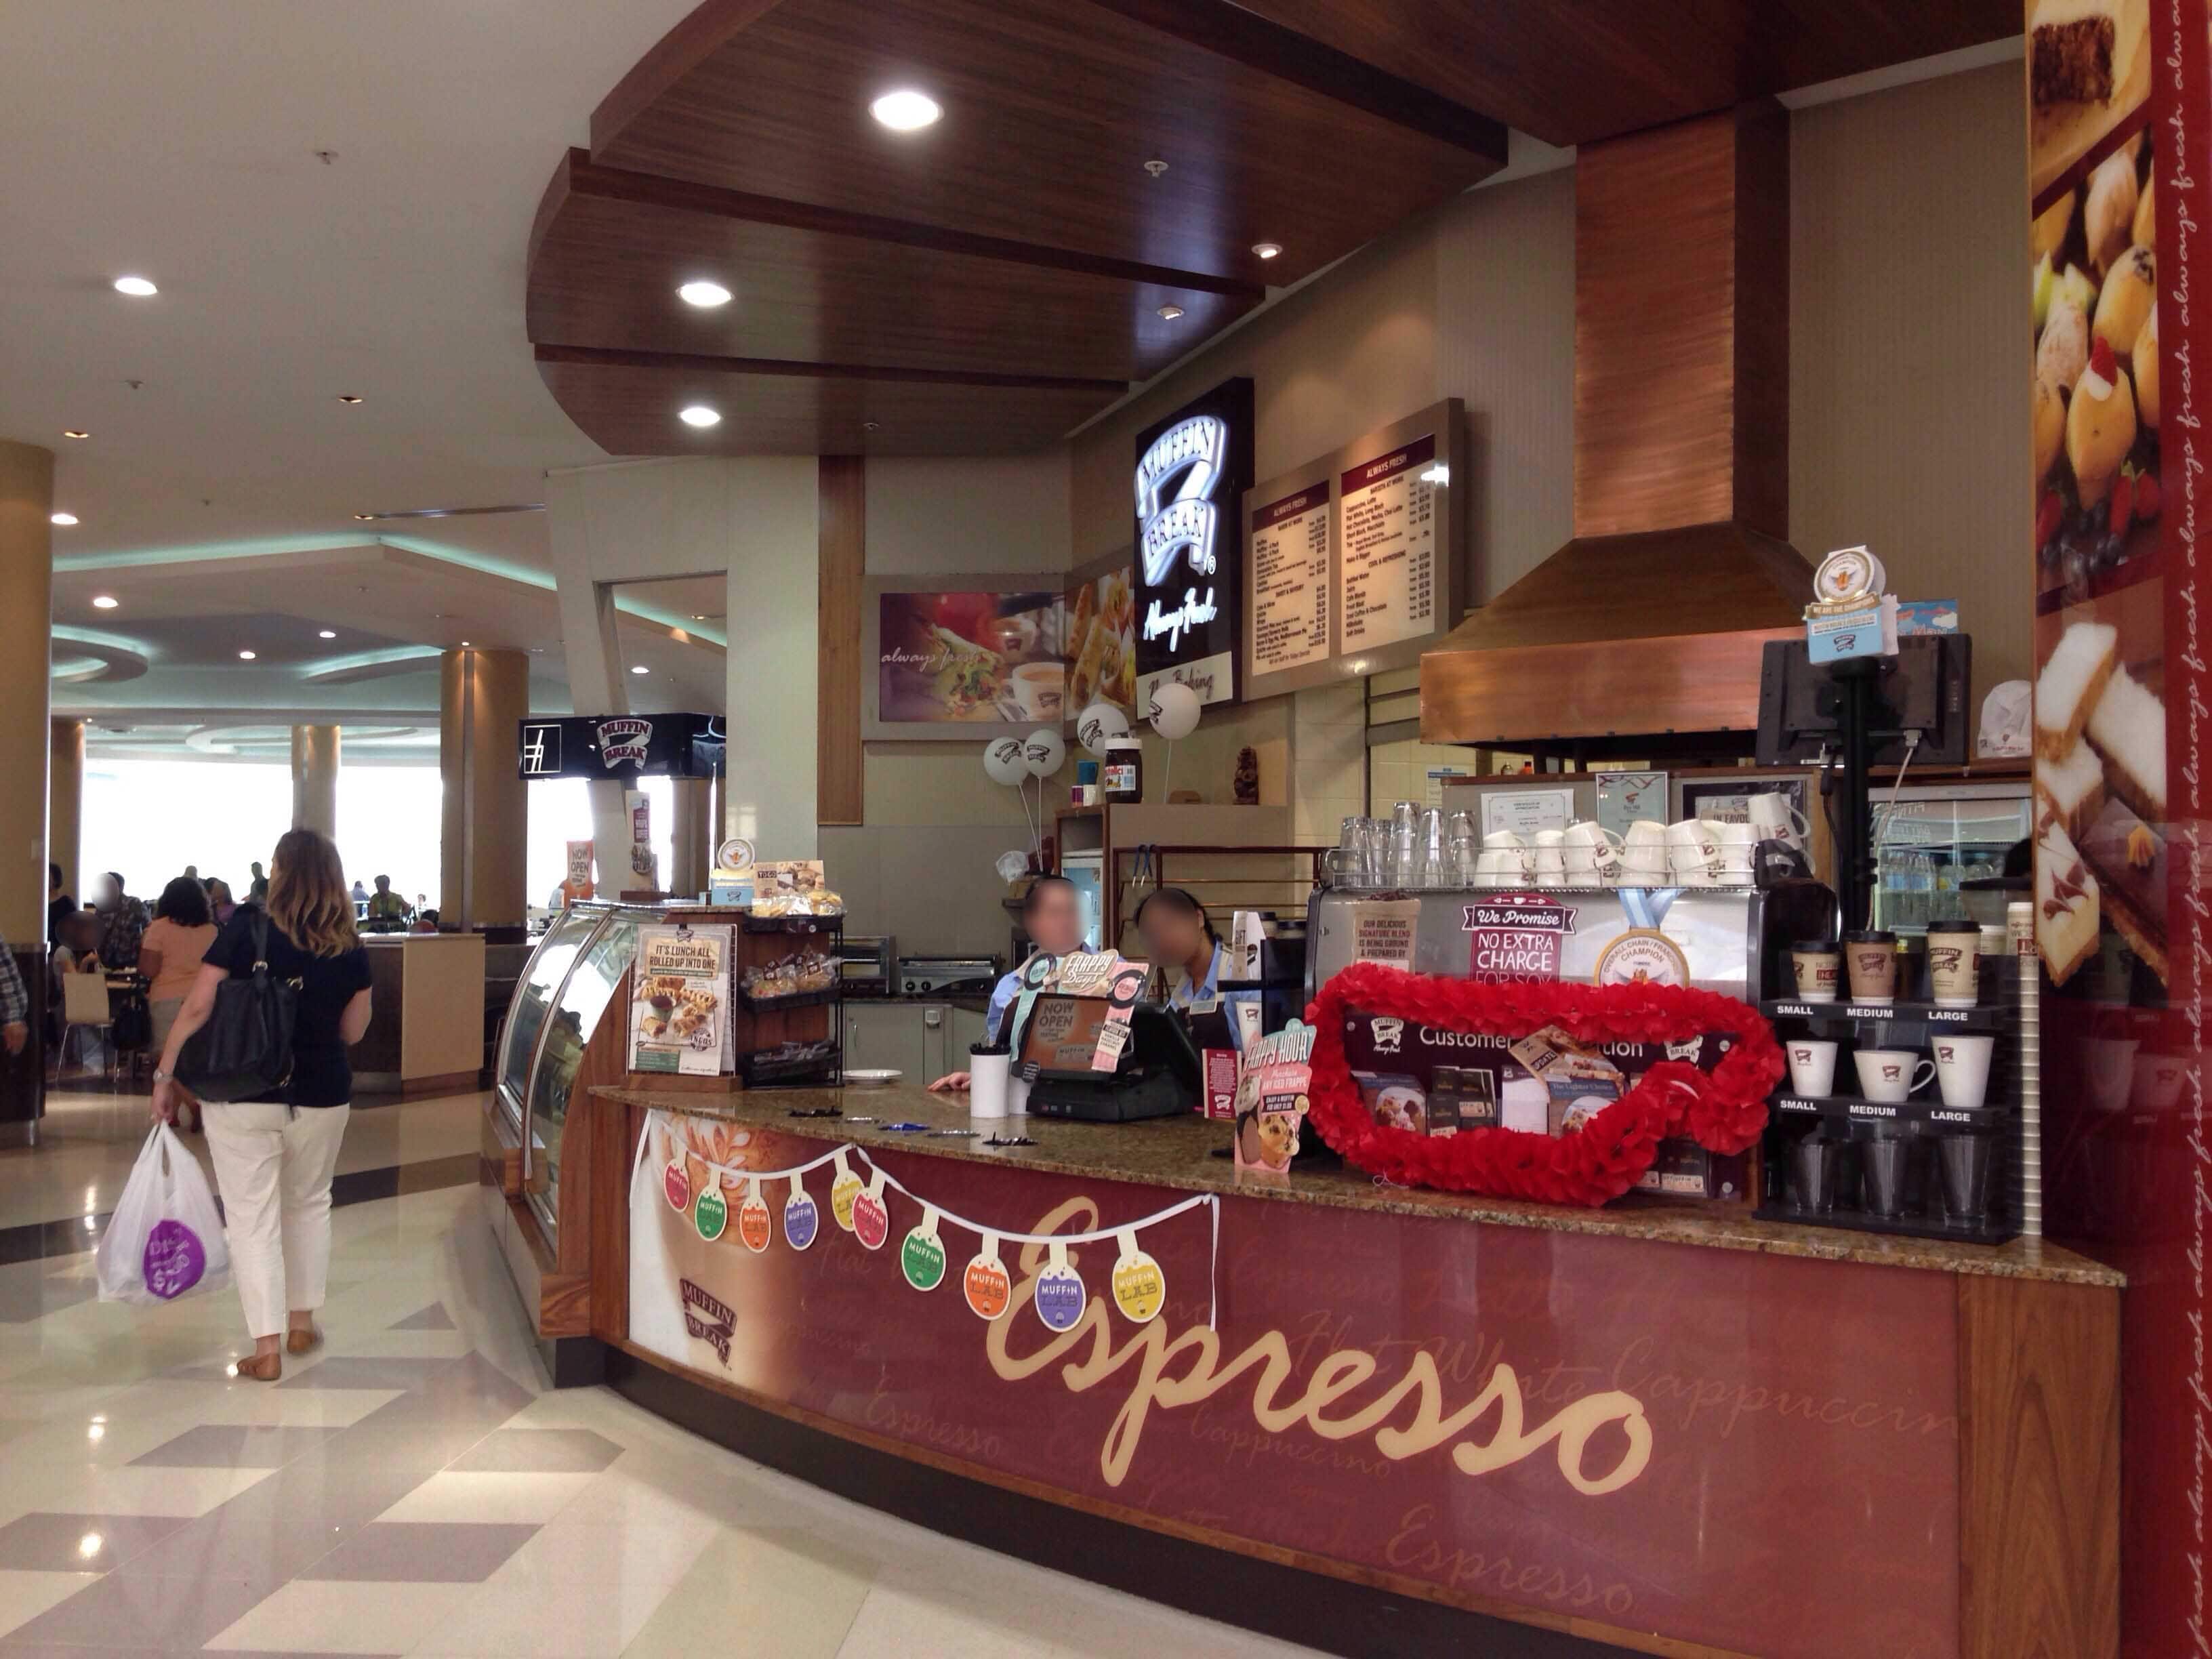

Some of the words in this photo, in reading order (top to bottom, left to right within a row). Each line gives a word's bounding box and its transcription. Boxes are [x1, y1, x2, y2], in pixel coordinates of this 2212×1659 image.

[2169, 103, 2194, 188] fresh
[2173, 199, 2198, 327] always
[2175, 340, 2202, 428] fresh
[1141, 422, 1214, 485] MUFFIN
[1366, 460, 1389, 479] ALWAYS
[1389, 453, 1407, 469] FRESH
[1273, 502, 1291, 517] ALWAYS
[1292, 495, 1307, 510] FRESH
[2179, 437, 2205, 567] always
[1147, 505, 1204, 556] BREAK
[2180, 581, 2207, 672] fresh
[881, 647, 936, 672] always
[601, 720, 649, 737] MUFFIN
[605, 745, 645, 760] BREAK
[2182, 680, 2209, 810] always
[572, 848, 588, 859] NOW
[571, 861, 589, 873] OPEN
[2184, 820, 2210, 918] fresh
[1477, 909, 1500, 924] We
[1502, 910, 1560, 926] Promise
[656, 945, 670, 955] IT'S
[672, 946, 695, 956] LUNCH
[697, 947, 710, 957] ALL
[1478, 933, 1499, 949] NO
[1504, 933, 1553, 950] EXTRA
[650, 956, 674, 966] ROLLED
[675, 958, 684, 967] UP
[686, 958, 701, 968] INTO
[702, 960, 716, 969] ONE
[1065, 955, 1113, 972] FRAPPY
[1477, 950, 1553, 971] CHARGE
[1620, 948, 1665, 963] CHAMPION
[1476, 970, 1510, 986] FOR
[1515, 971, 1551, 986] SOY
[2186, 921, 2212, 1053] always
[1044, 1002, 1074, 1014] NOW
[1777, 1006, 1814, 1016] SMALL
[1847, 1008, 1893, 1018] MEDIUM
[1928, 1011, 1968, 1021] LARGE
[1039, 1017, 1073, 1027] OPEN
[1244, 1036, 1278, 1071] FRAPPY
[1278, 1031, 1309, 1063] HOUR
[1669, 1048, 1696, 1057] BREAK
[1780, 1100, 1816, 1111] SMALL
[1849, 1105, 1896, 1116] MEDIUM
[2186, 1064, 2212, 1164] fresh
[1931, 1111, 1971, 1122] LARGE
[668, 1170, 687, 1190] MUFFIN
[700, 1202, 722, 1215] MUFFIN
[788, 1208, 812, 1221] MUFFIN
[858, 1200, 884, 1225] MUFFIN
[2187, 1164, 2212, 1298] always
[909, 1242, 940, 1263] MUFFIN
[970, 1272, 1004, 1288] MUFFIN
[1118, 1271, 1154, 1288] MUFFIN
[970, 1284, 1004, 1300] LAB
[1042, 1285, 1078, 1295] MUFFIN
[1120, 1282, 1158, 1302] LAB
[683, 1282, 733, 1324] MUFFIN
[1041, 1295, 1078, 1307] LAB
[687, 1316, 727, 1354] BREAK
[987, 1197, 1652, 1496] Espresso
[2187, 1308, 2212, 1412] fresh
[1612, 1334, 1957, 1439] Cappuccin
[1190, 1404, 1395, 1479] Cappuccino
[2188, 1408, 2212, 1544] always
[1386, 1503, 1633, 1614] Espresso
[2187, 1552, 2212, 1658] fresh
